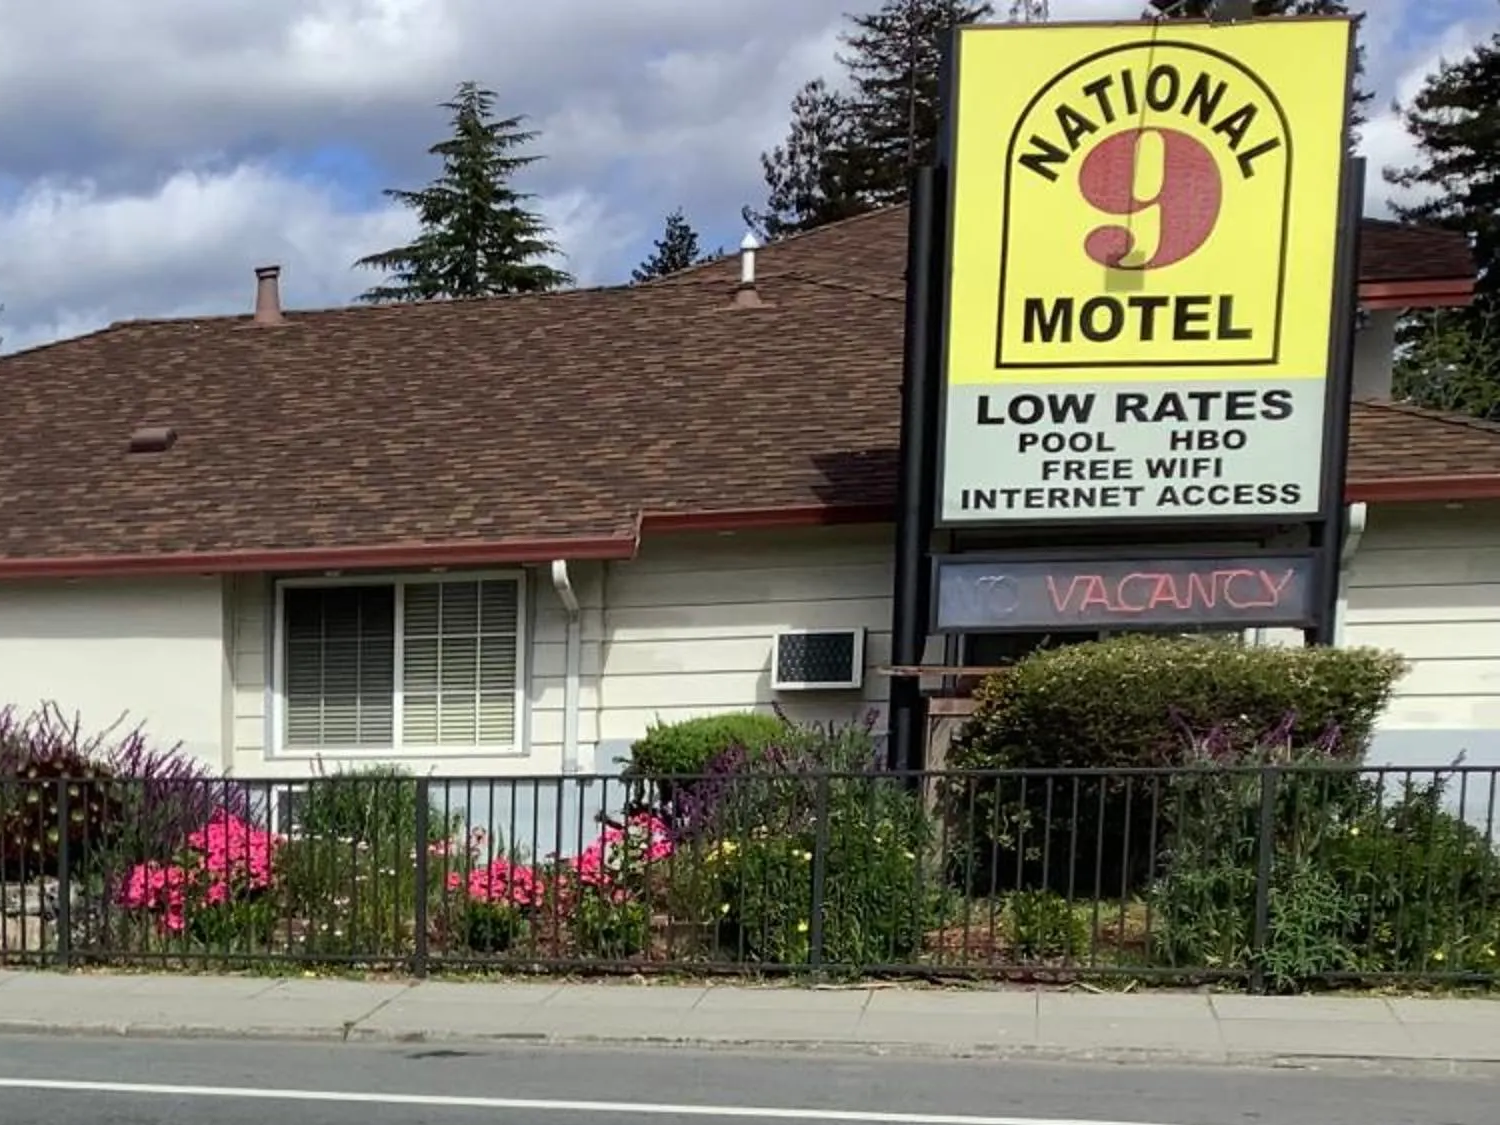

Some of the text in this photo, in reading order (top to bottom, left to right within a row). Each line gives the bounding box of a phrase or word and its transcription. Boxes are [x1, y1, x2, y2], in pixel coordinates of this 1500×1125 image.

[1018, 64, 1281, 183] NATIONAL
[1078, 127, 1222, 270] 9
[1023, 295, 1253, 344] MOTEL
[977, 390, 1293, 425] LOW RATES
[1018, 429, 1247, 453] POOL HBO
[1042, 458, 1223, 480] FREE WIFI
[961, 483, 1301, 510] INTERNET ACCESS
[1045, 568, 1294, 612] VACANCY
